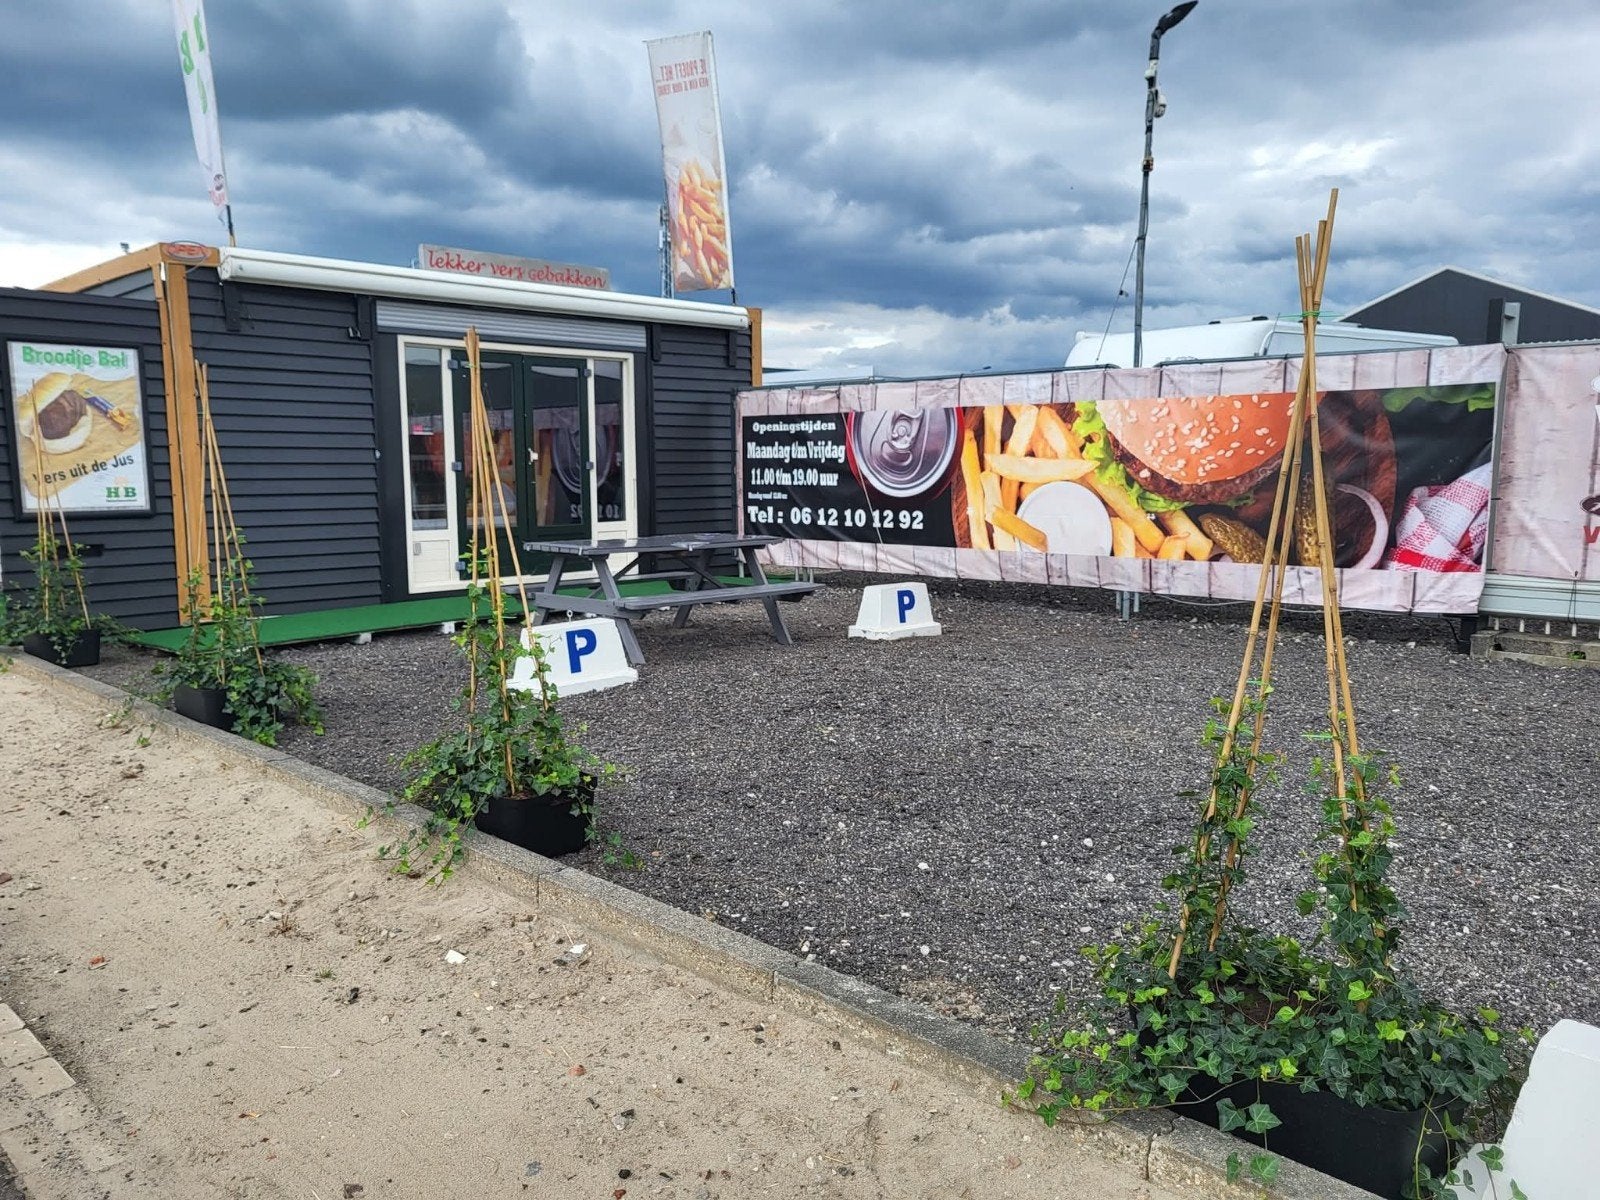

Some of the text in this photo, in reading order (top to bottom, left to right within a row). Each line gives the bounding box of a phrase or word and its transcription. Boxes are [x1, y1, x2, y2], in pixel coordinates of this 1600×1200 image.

[428, 250, 486, 273] lekker
[491, 262, 525, 281] vers
[22, 346, 128, 368] Broodje Bal
[752, 420, 836, 434] Openingstijden
[747, 440, 790, 463] Maandag
[807, 440, 846, 463] Vrijdag
[69, 463, 90, 478] uit
[91, 460, 108, 473] de
[111, 454, 134, 468] Jus
[751, 467, 839, 486] 11.00 t/m 19.00 uur
[790, 507, 812, 525] 06
[817, 508, 839, 526] 12
[844, 509, 867, 527] 10
[872, 509, 894, 528] 12
[898, 510, 924, 529] 92
[897, 589, 916, 624] P
[565, 628, 597, 674] P
